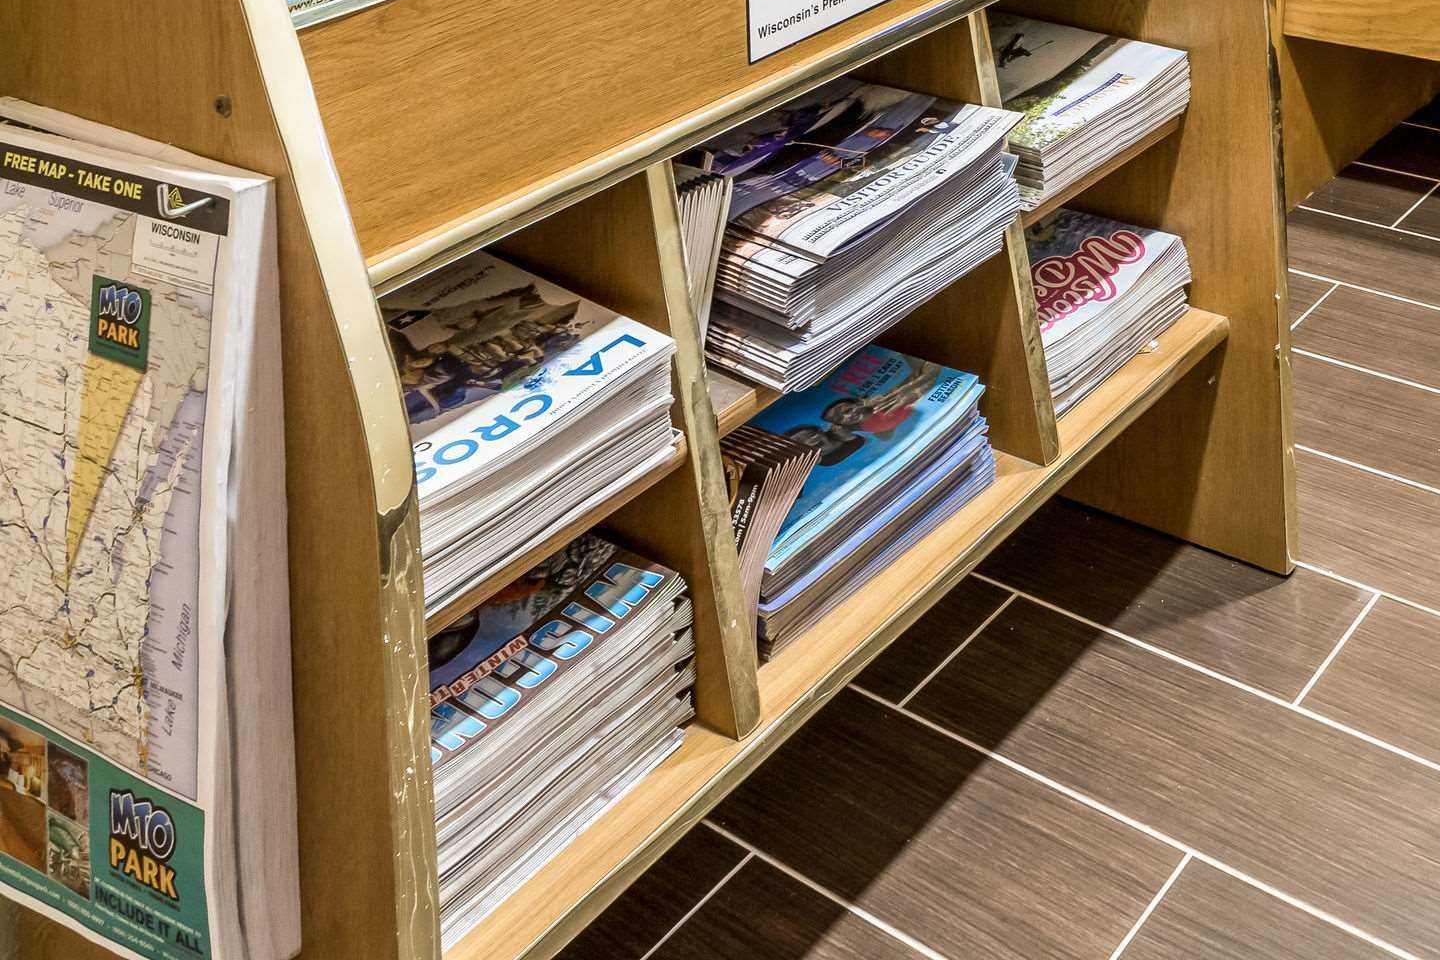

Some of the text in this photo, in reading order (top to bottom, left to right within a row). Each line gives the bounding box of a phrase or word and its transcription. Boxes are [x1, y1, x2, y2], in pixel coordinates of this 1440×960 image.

[758, 0, 820, 39] Wisconsin's
[3, 152, 37, 173] FREE
[38, 159, 67, 179] MAP
[77, 169, 110, 191] TAKE
[113, 180, 142, 200] ONE
[3, 183, 85, 214] Lake Superior
[826, 166, 901, 213] VISITOR
[151, 221, 200, 245] WISCONSIN
[562, 333, 646, 376] LA
[171, 602, 191, 672] Michigan
[110, 791, 175, 860] MTO
[109, 837, 179, 901] PARK
[95, 885, 155, 930] INCLUDE
[175, 927, 204, 954] ALL
